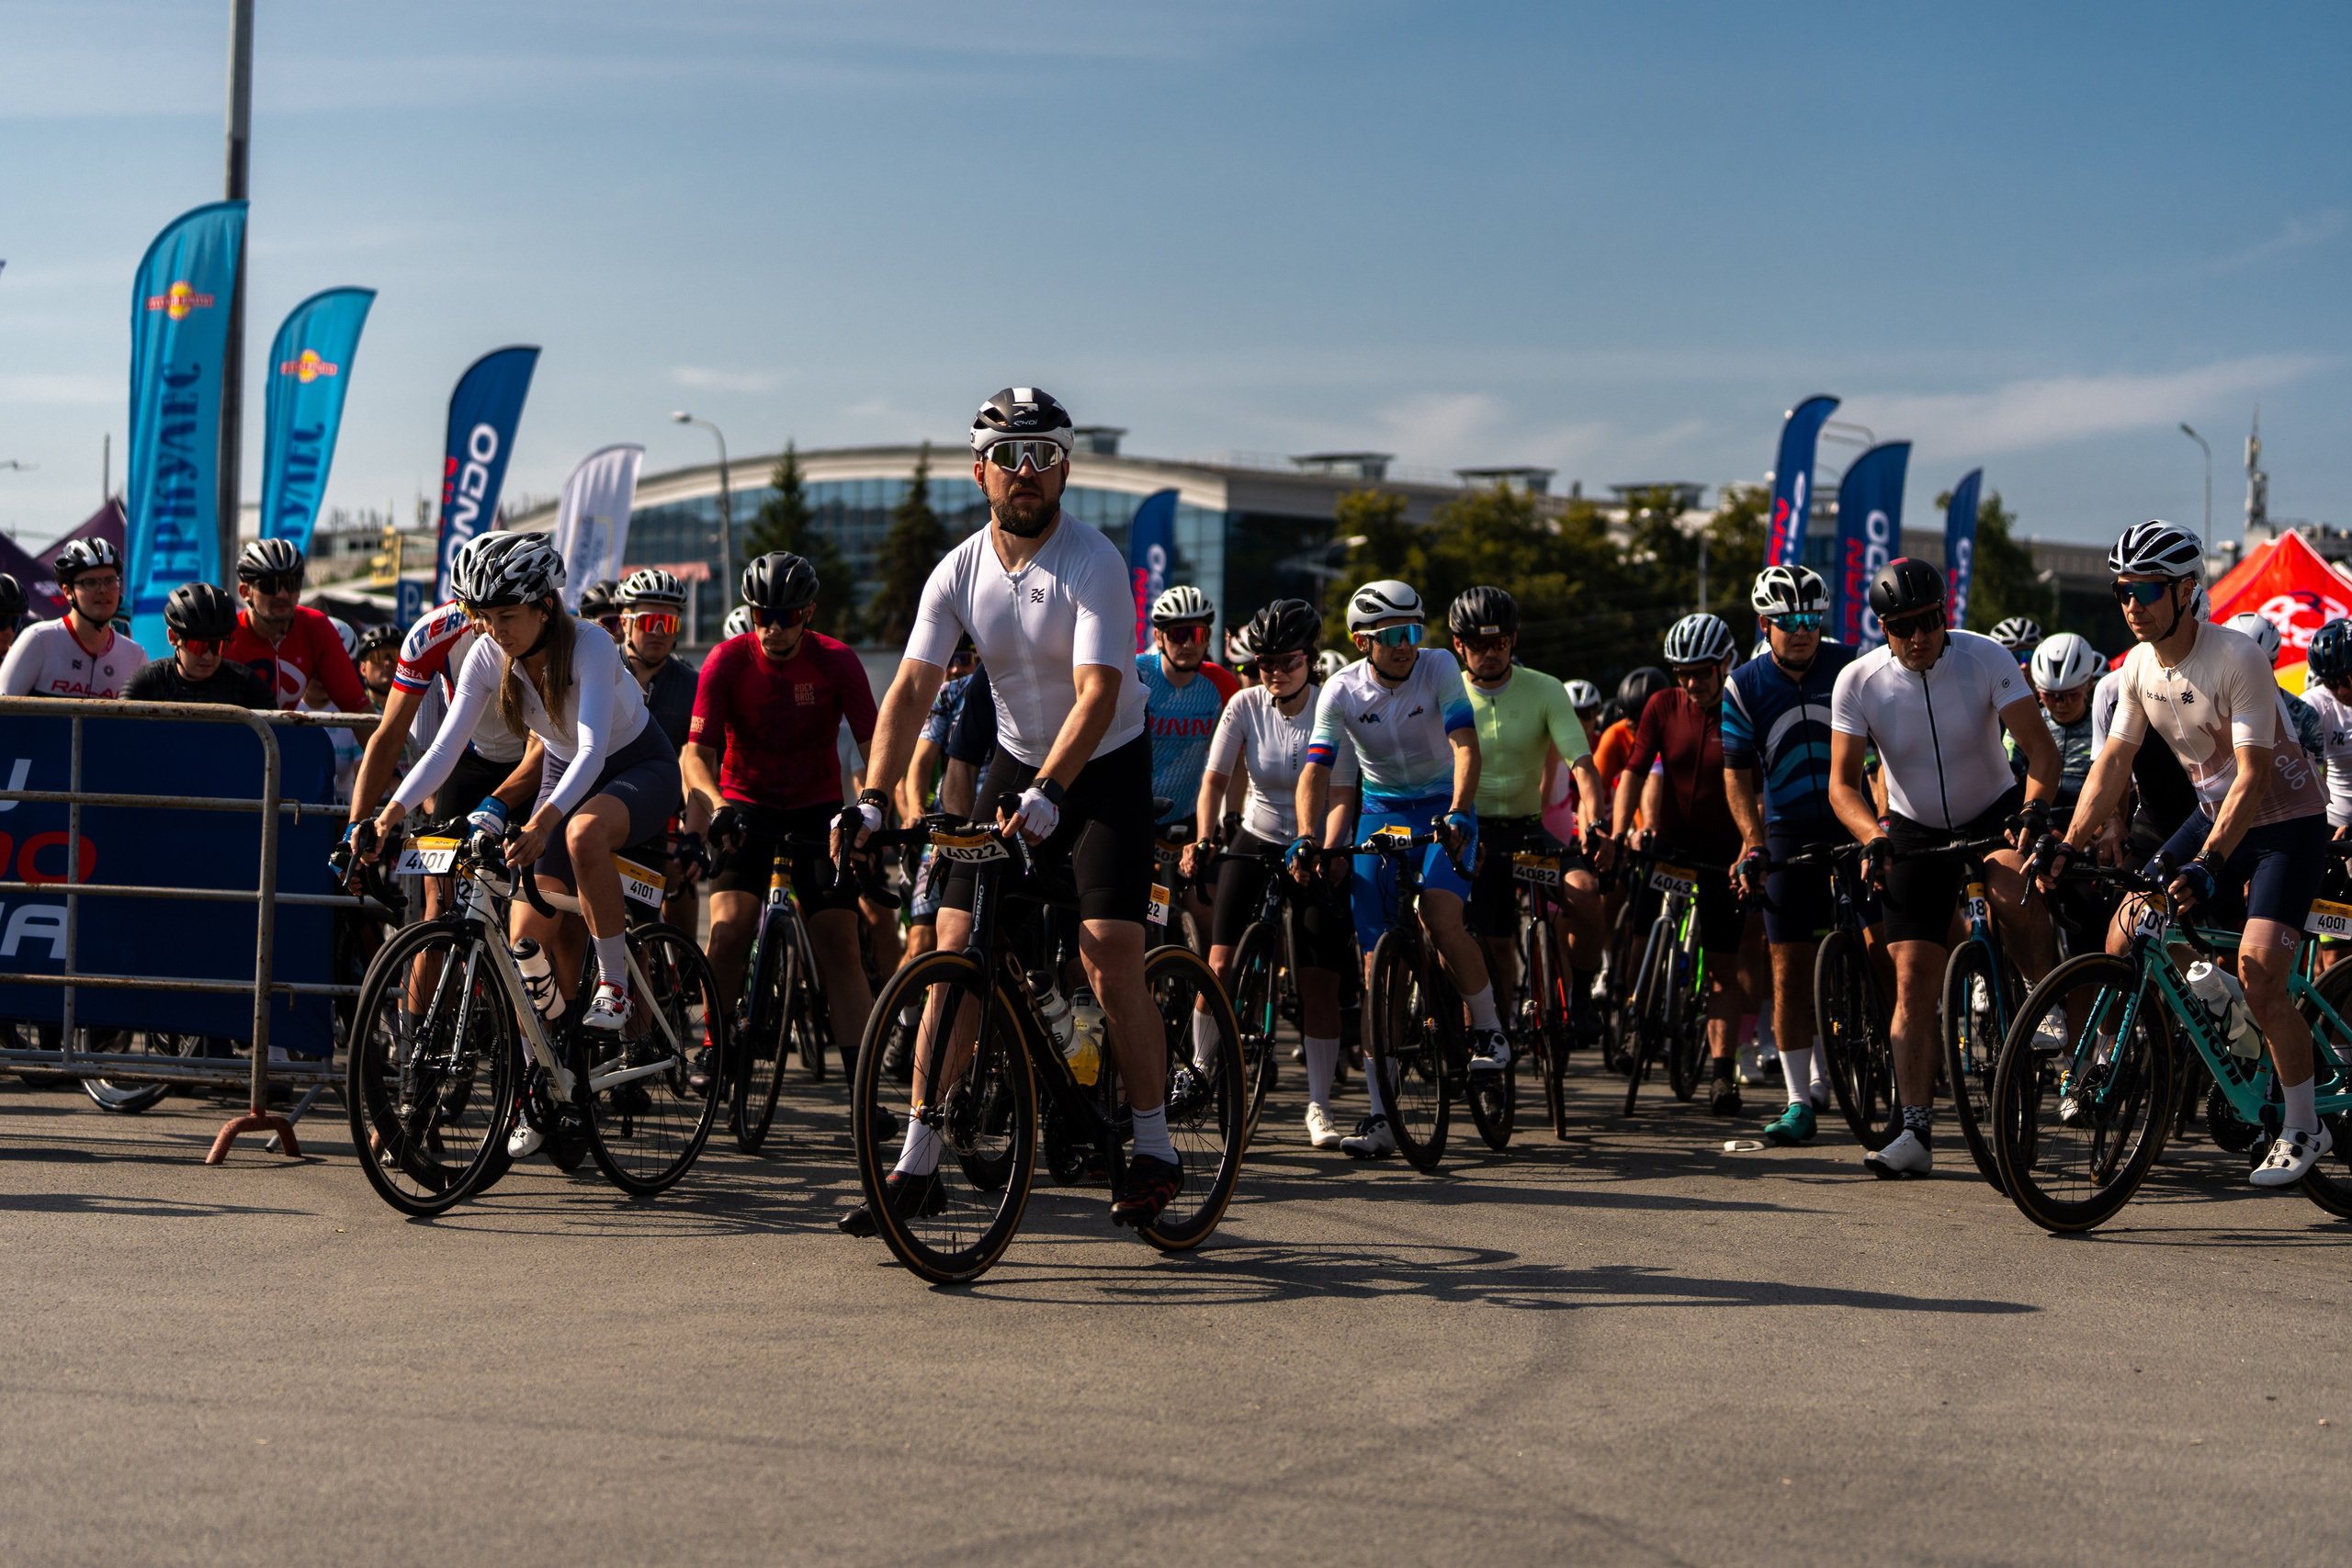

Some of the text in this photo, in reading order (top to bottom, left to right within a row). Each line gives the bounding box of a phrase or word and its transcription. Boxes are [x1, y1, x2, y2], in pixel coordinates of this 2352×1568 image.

[795, 682, 814, 694] ROCK
[2146, 689, 2154, 699] bc
[795, 693, 816, 703] BROS
[2274, 754, 2310, 791] club
[405, 852, 447, 870] 4101
[946, 844, 1002, 861] 4022
[1516, 866, 1558, 885] 4082
[1653, 874, 1693, 896] 4043
[630, 880, 654, 900] 4101
[769, 888, 790, 908] 06
[972, 884, 985, 933] ORBEA
[2317, 914, 2346, 931] 4001
[2110, 991, 2138, 1064] Bianchi
[2163, 962, 2244, 1087] Bianchi
